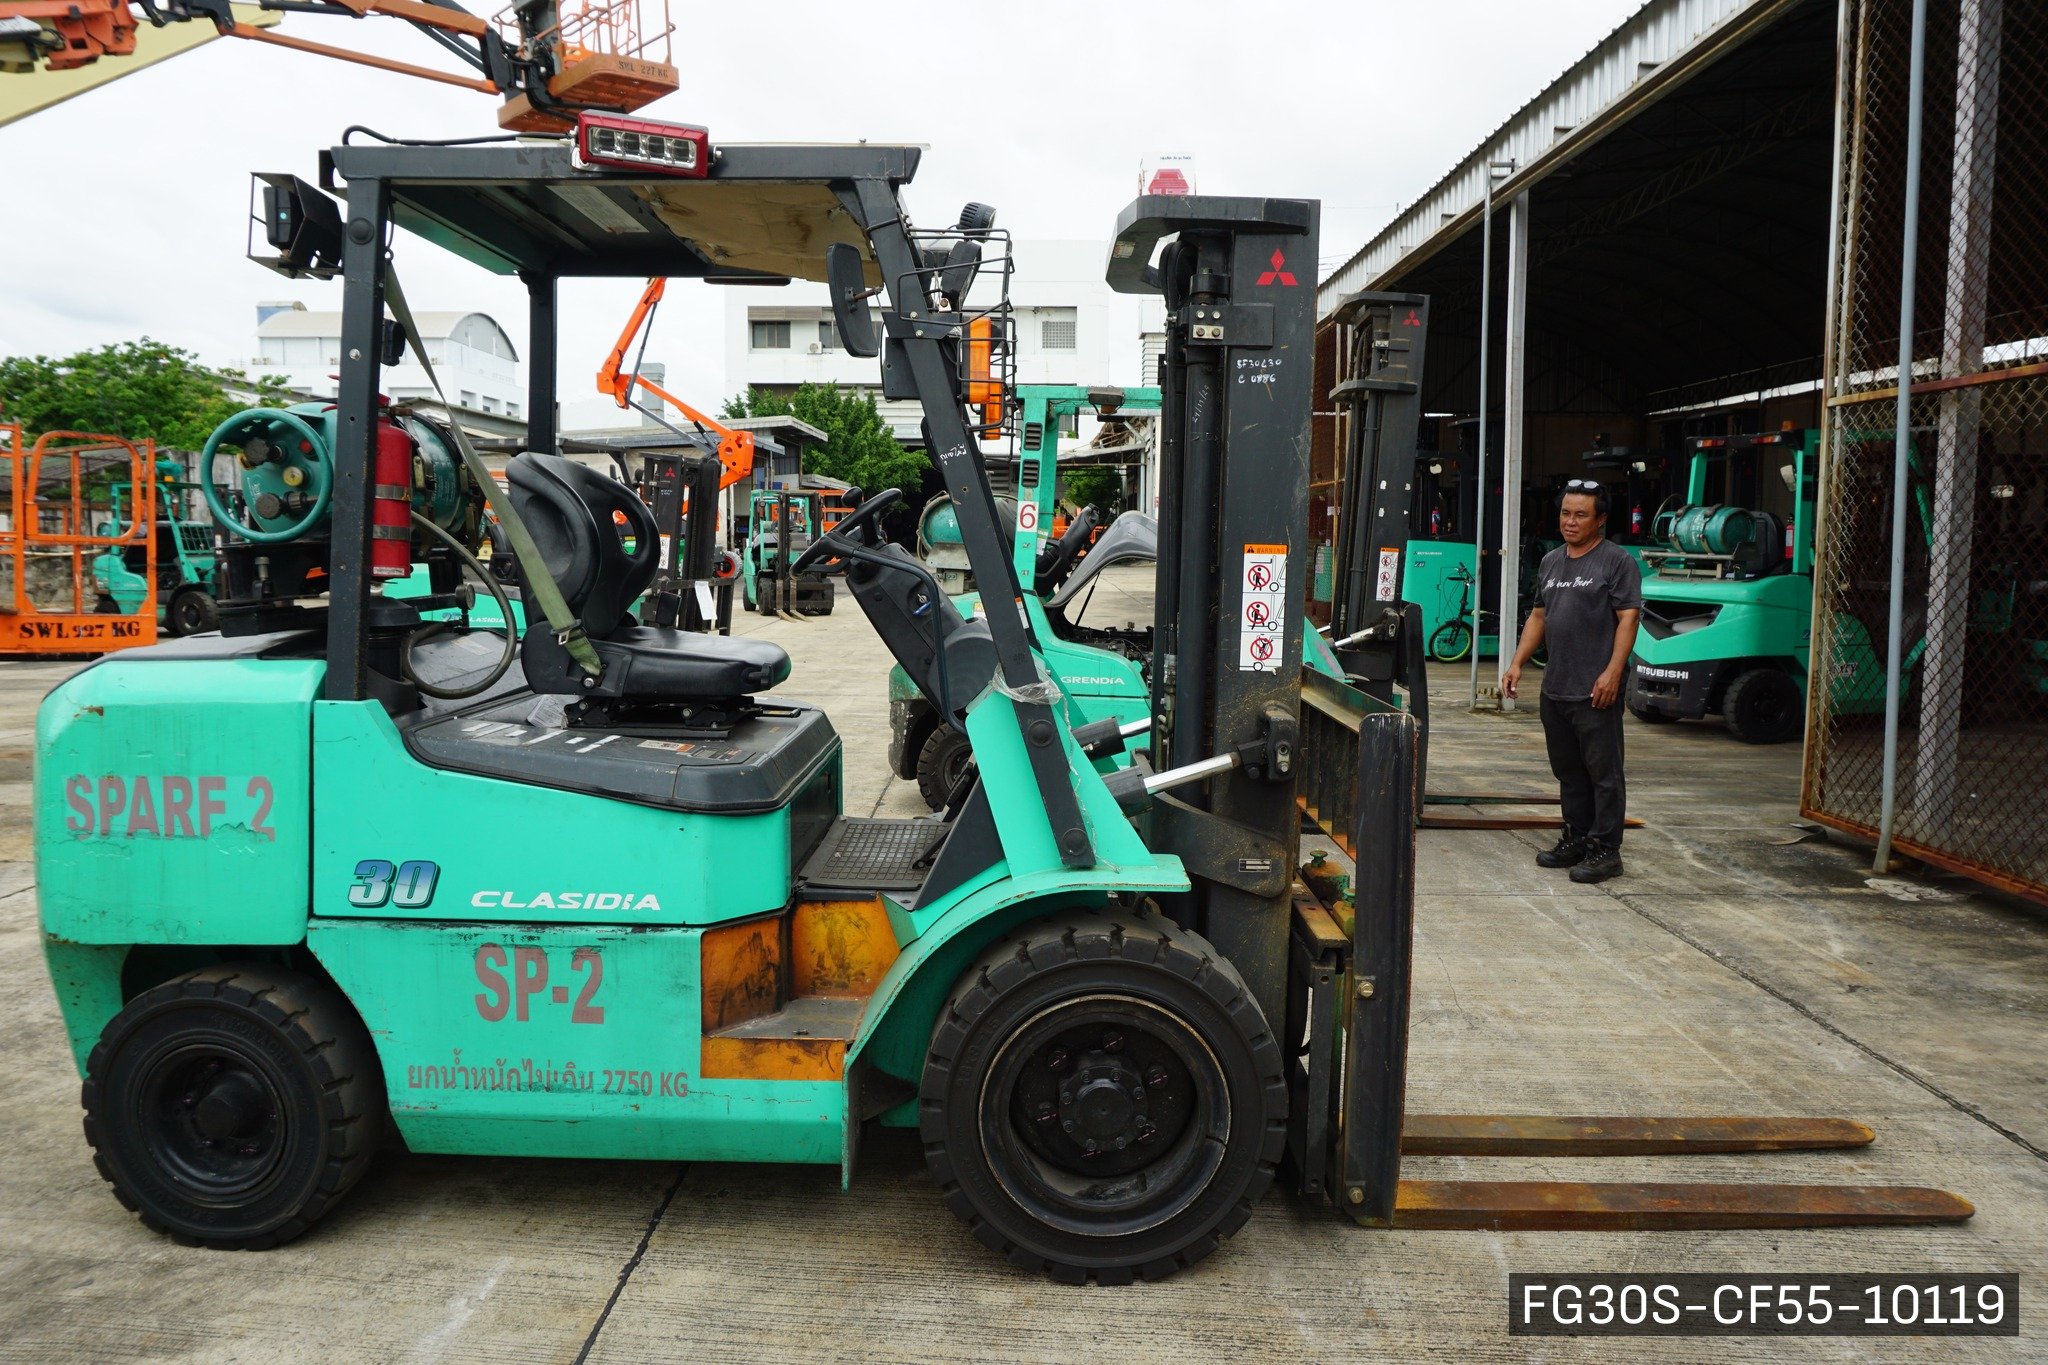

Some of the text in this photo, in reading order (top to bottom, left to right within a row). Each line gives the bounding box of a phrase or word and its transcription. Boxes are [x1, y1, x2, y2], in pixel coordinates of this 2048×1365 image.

[1020, 504, 1036, 529] 6
[20, 622, 69, 639] SWL
[111, 621, 140, 637] KG
[1060, 675, 1126, 686] GRENDIA
[1636, 664, 1690, 680] MITSUBISHI
[246, 775, 276, 843] 2
[347, 859, 661, 912] 30 CLASIDIA
[474, 942, 605, 1025] SP-2
[602, 1069, 652, 1096] 2750
[659, 1071, 689, 1098] KG
